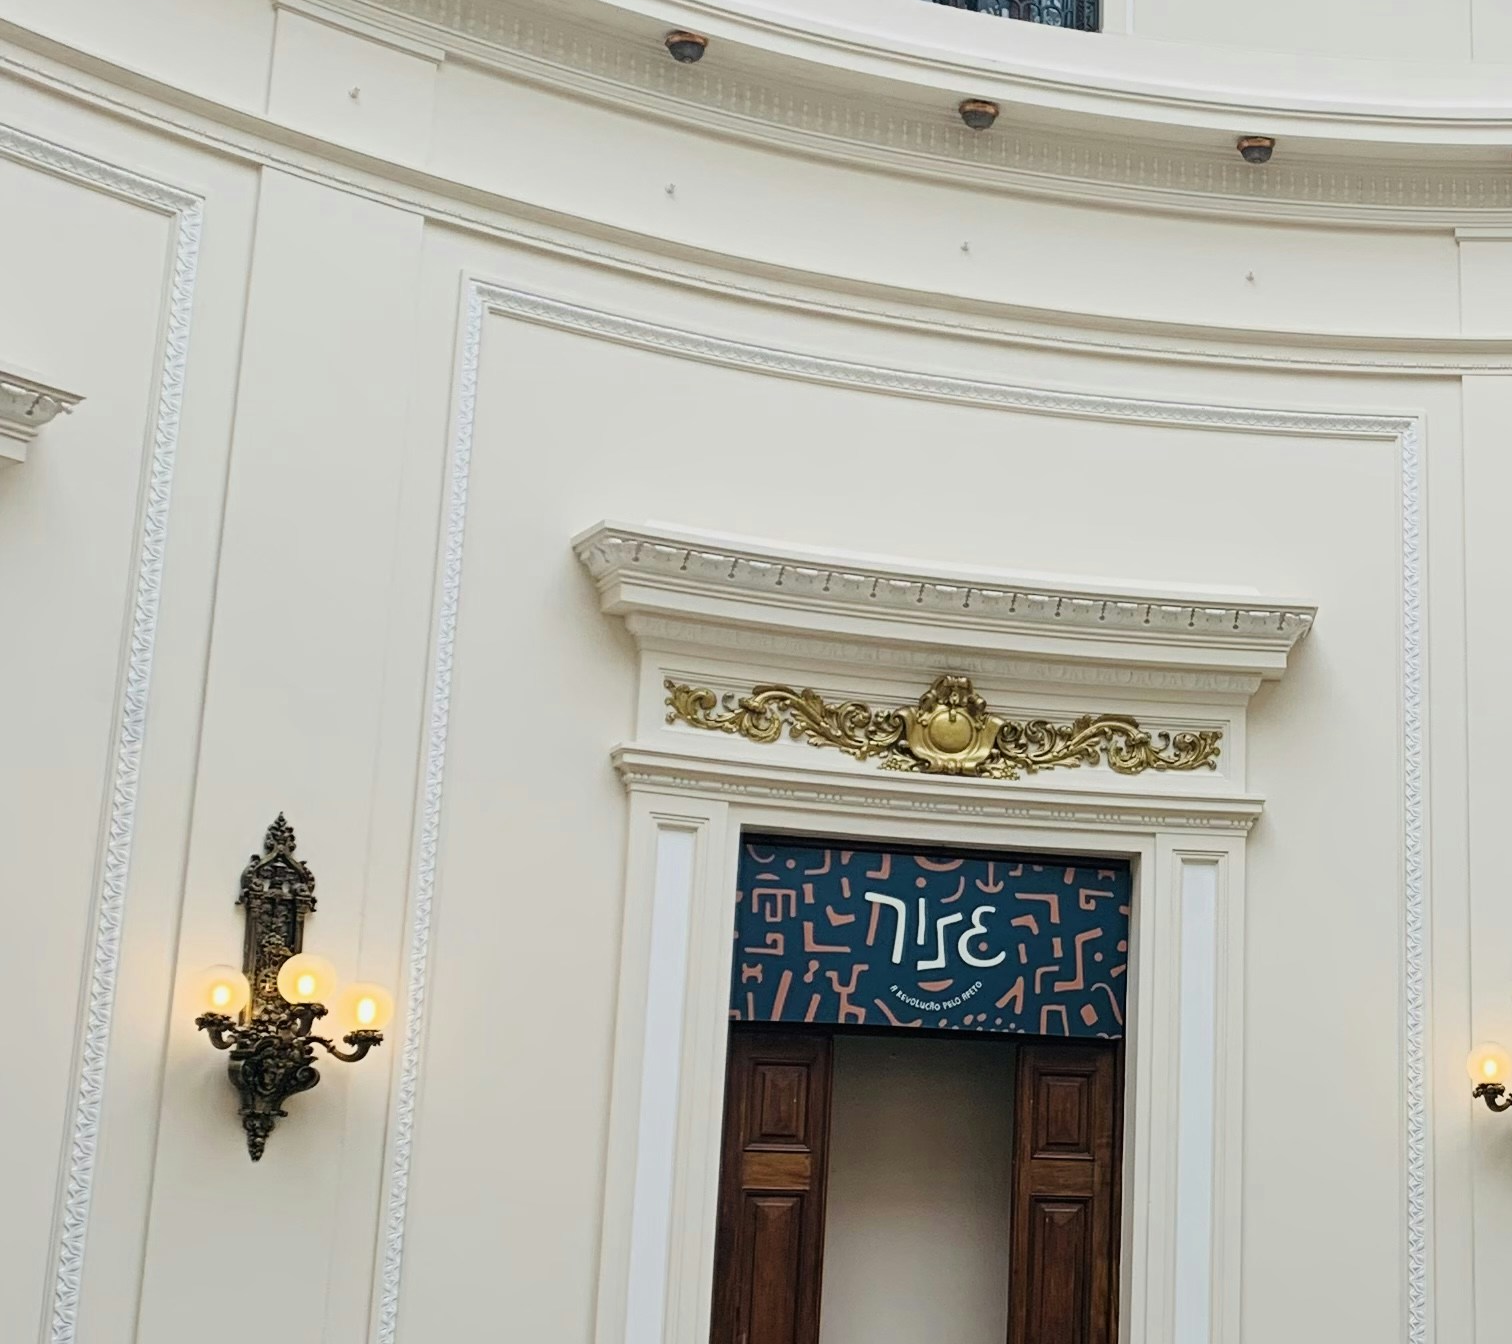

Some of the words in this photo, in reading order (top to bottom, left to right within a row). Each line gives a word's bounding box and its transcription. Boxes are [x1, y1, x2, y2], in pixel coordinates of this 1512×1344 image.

[890, 984, 899, 992] A
[942, 997, 962, 1010] PELO
[962, 981, 982, 1001] AFETO
